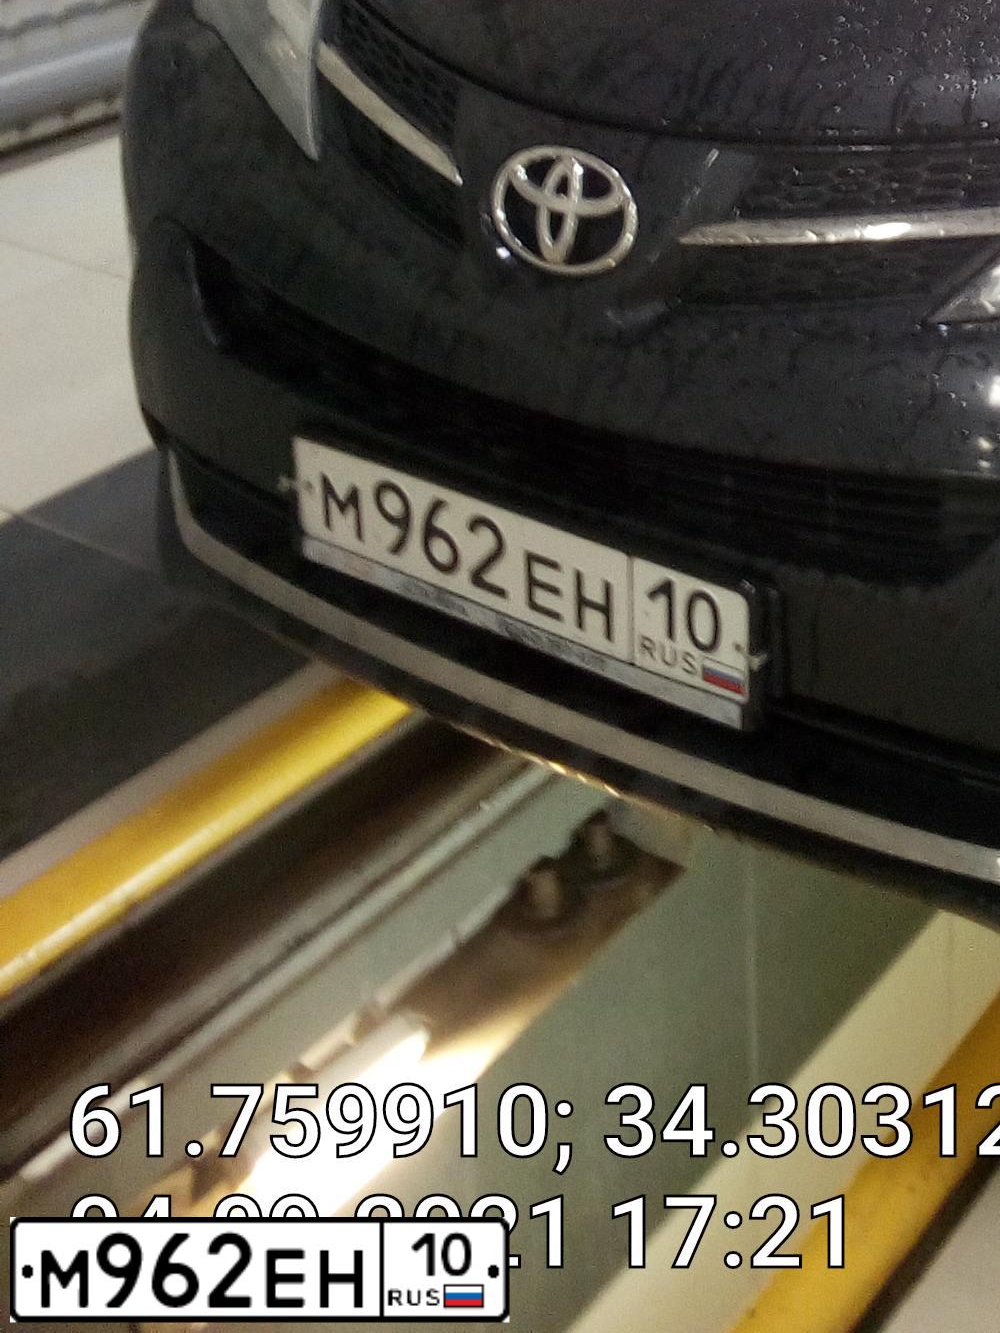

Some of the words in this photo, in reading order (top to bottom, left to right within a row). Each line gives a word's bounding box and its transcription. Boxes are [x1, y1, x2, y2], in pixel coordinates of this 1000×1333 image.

[320, 474, 615, 642] M962EH
[645, 576, 721, 652] 10
[638, 634, 701, 676] RUS
